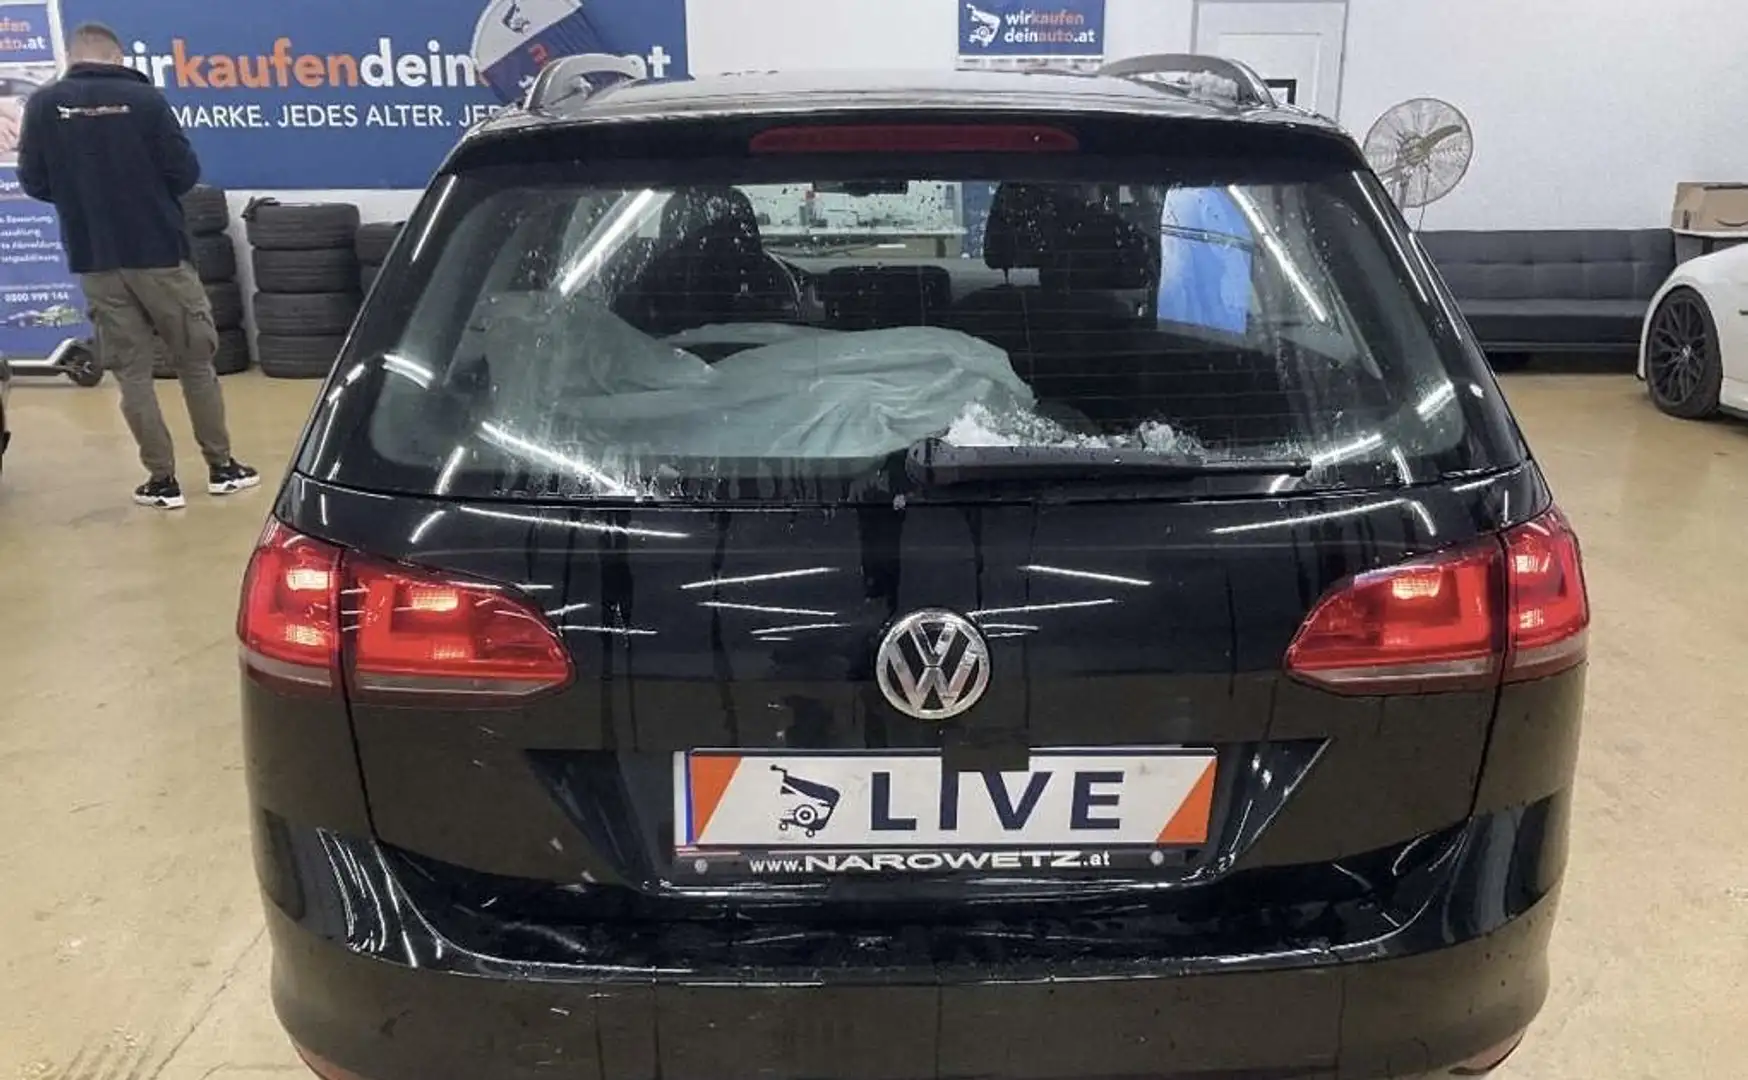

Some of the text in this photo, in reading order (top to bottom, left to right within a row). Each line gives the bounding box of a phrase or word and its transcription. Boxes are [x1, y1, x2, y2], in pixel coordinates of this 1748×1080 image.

[1005, 10, 1084, 26] wirkaufen
[1004, 26, 1095, 43] deinauto.at
[171, 105, 270, 128] MARKE.
[278, 105, 358, 127] JEDES
[366, 104, 452, 127] ALTER.
[870, 771, 1125, 831] LIVE
[750, 850, 1111, 873] www.NAROWETZ.at
